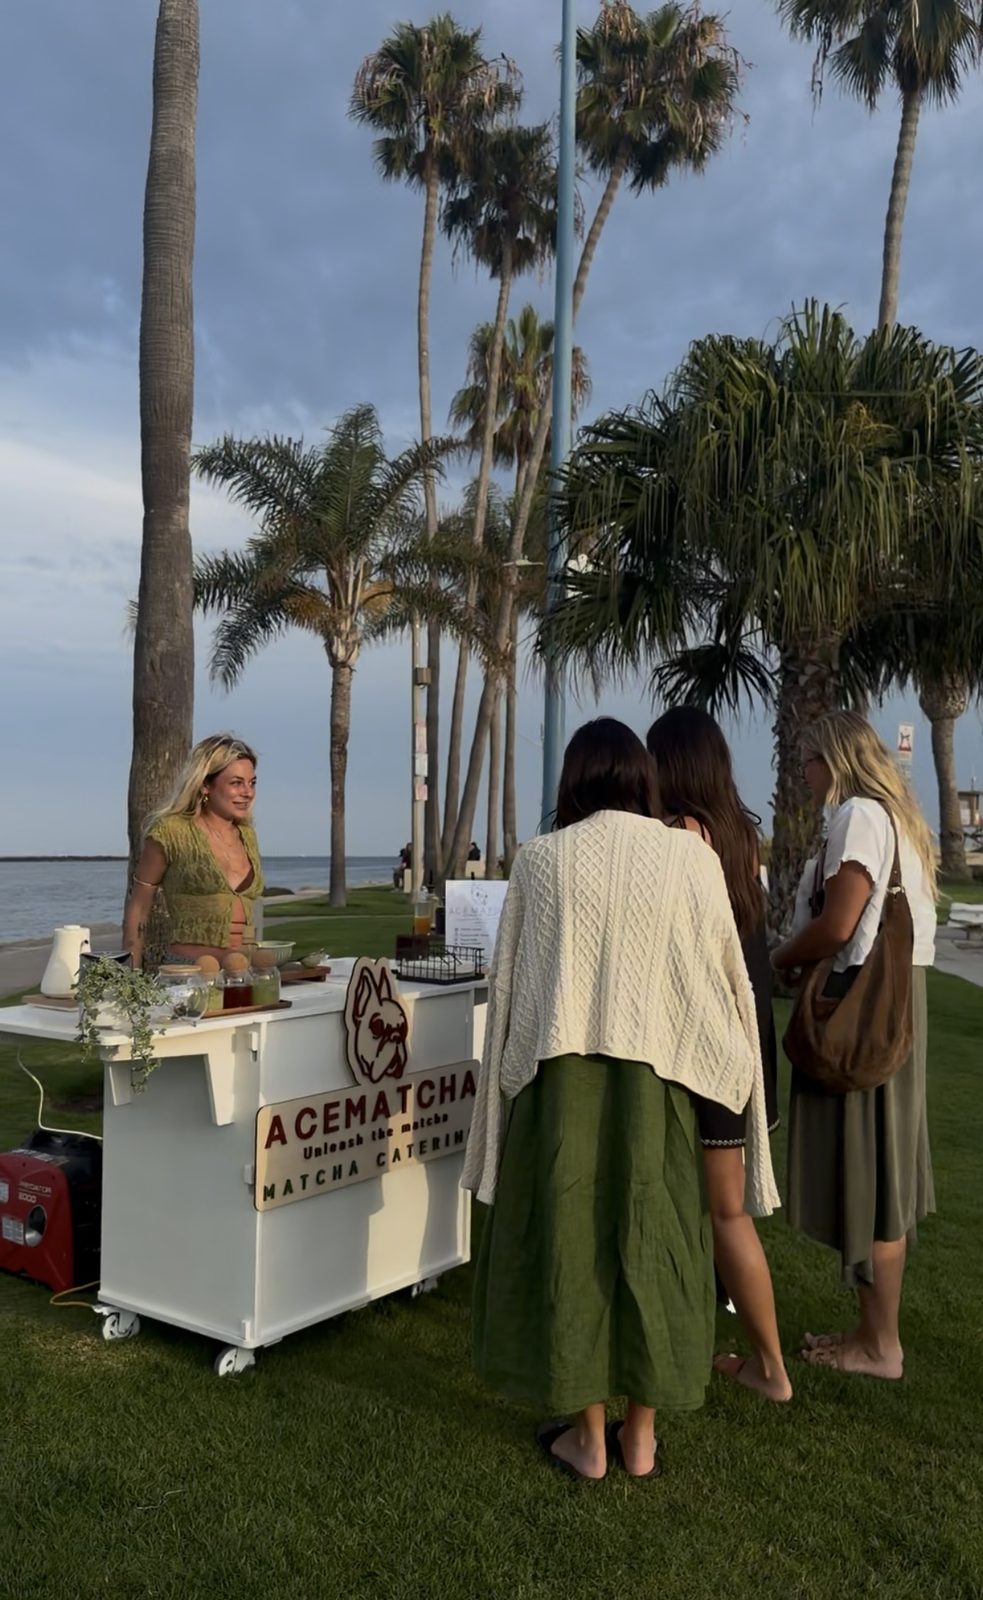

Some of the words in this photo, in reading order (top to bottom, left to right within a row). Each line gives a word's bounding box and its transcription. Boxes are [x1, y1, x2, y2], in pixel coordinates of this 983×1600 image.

[264, 1070, 477, 1149] ACEMATCHA
[303, 1133, 364, 1160] Unleash
[371, 1127, 394, 1142] the
[401, 1113, 449, 1134] matcha
[263, 1160, 359, 1201] MATCHA
[376, 1127, 471, 1168] CATERIN
